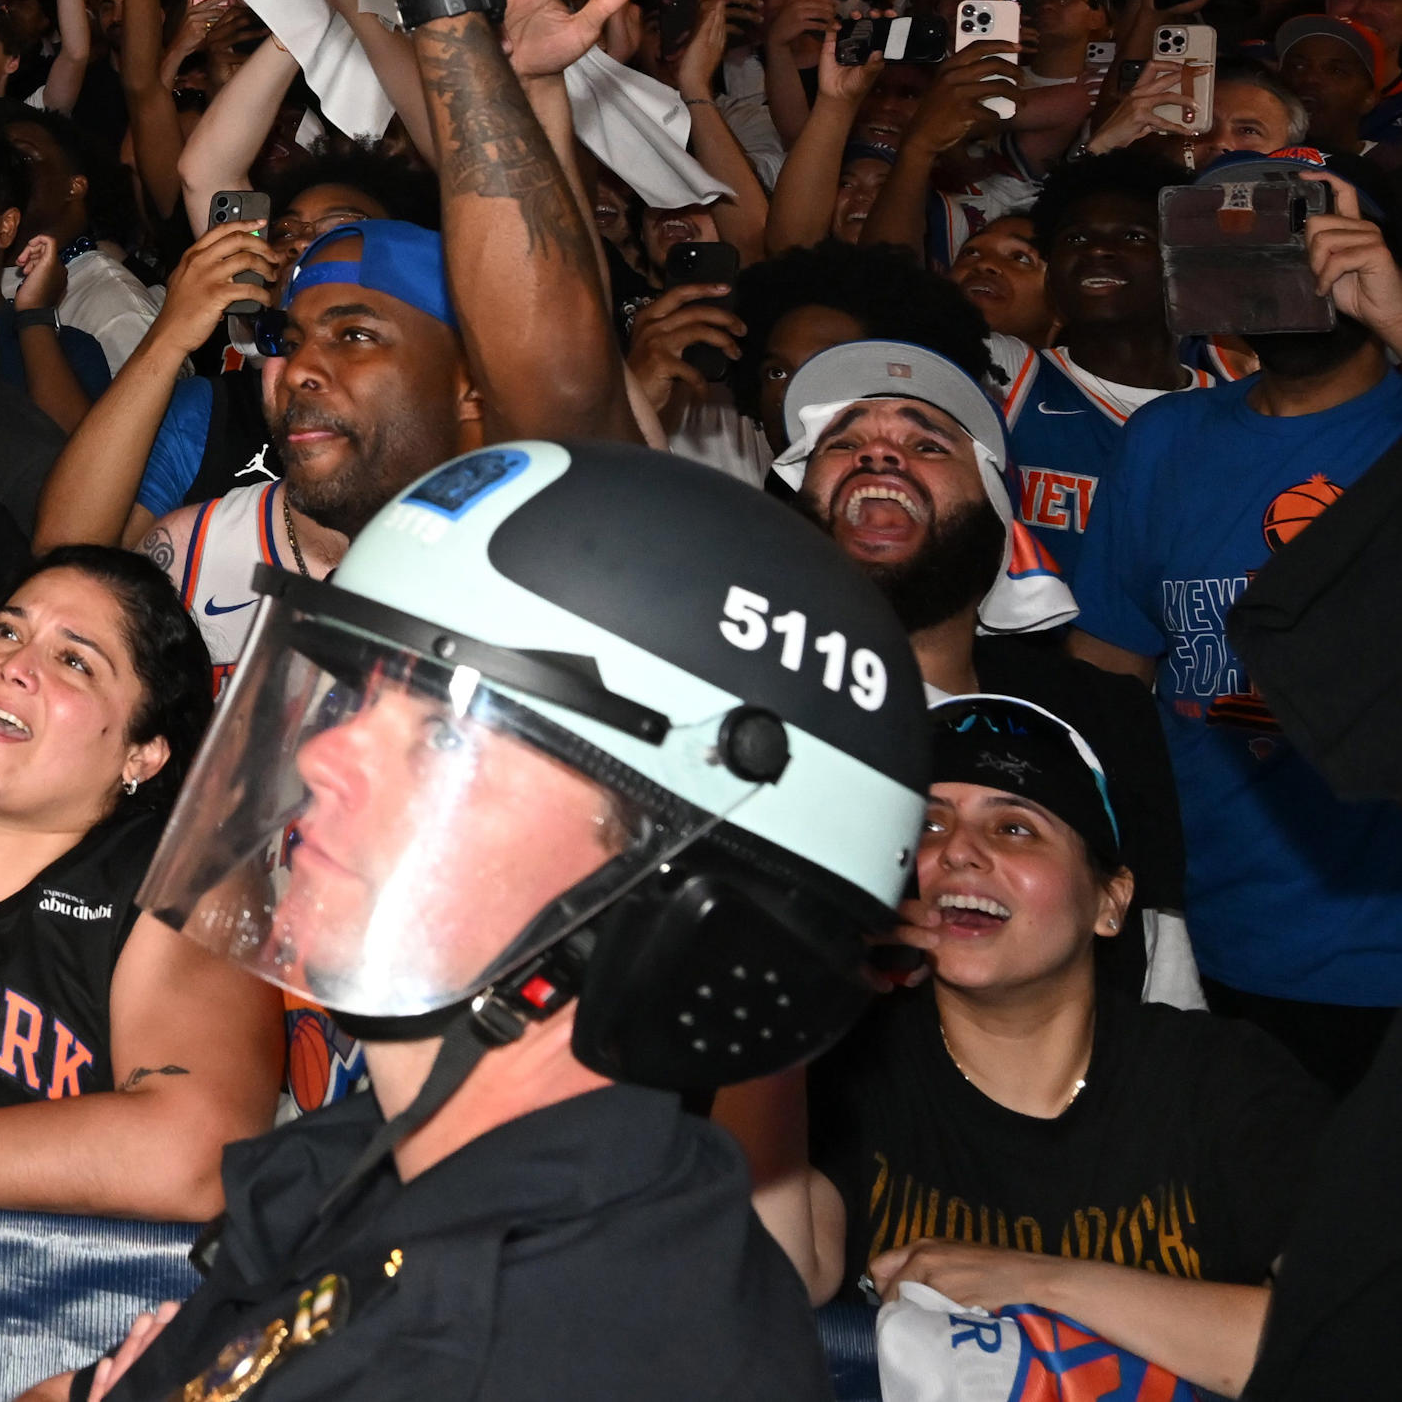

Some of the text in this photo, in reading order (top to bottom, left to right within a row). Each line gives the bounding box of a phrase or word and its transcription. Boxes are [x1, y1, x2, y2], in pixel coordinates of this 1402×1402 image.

[719, 585, 888, 712] 5119
[38, 897, 113, 921] abu dhabi
